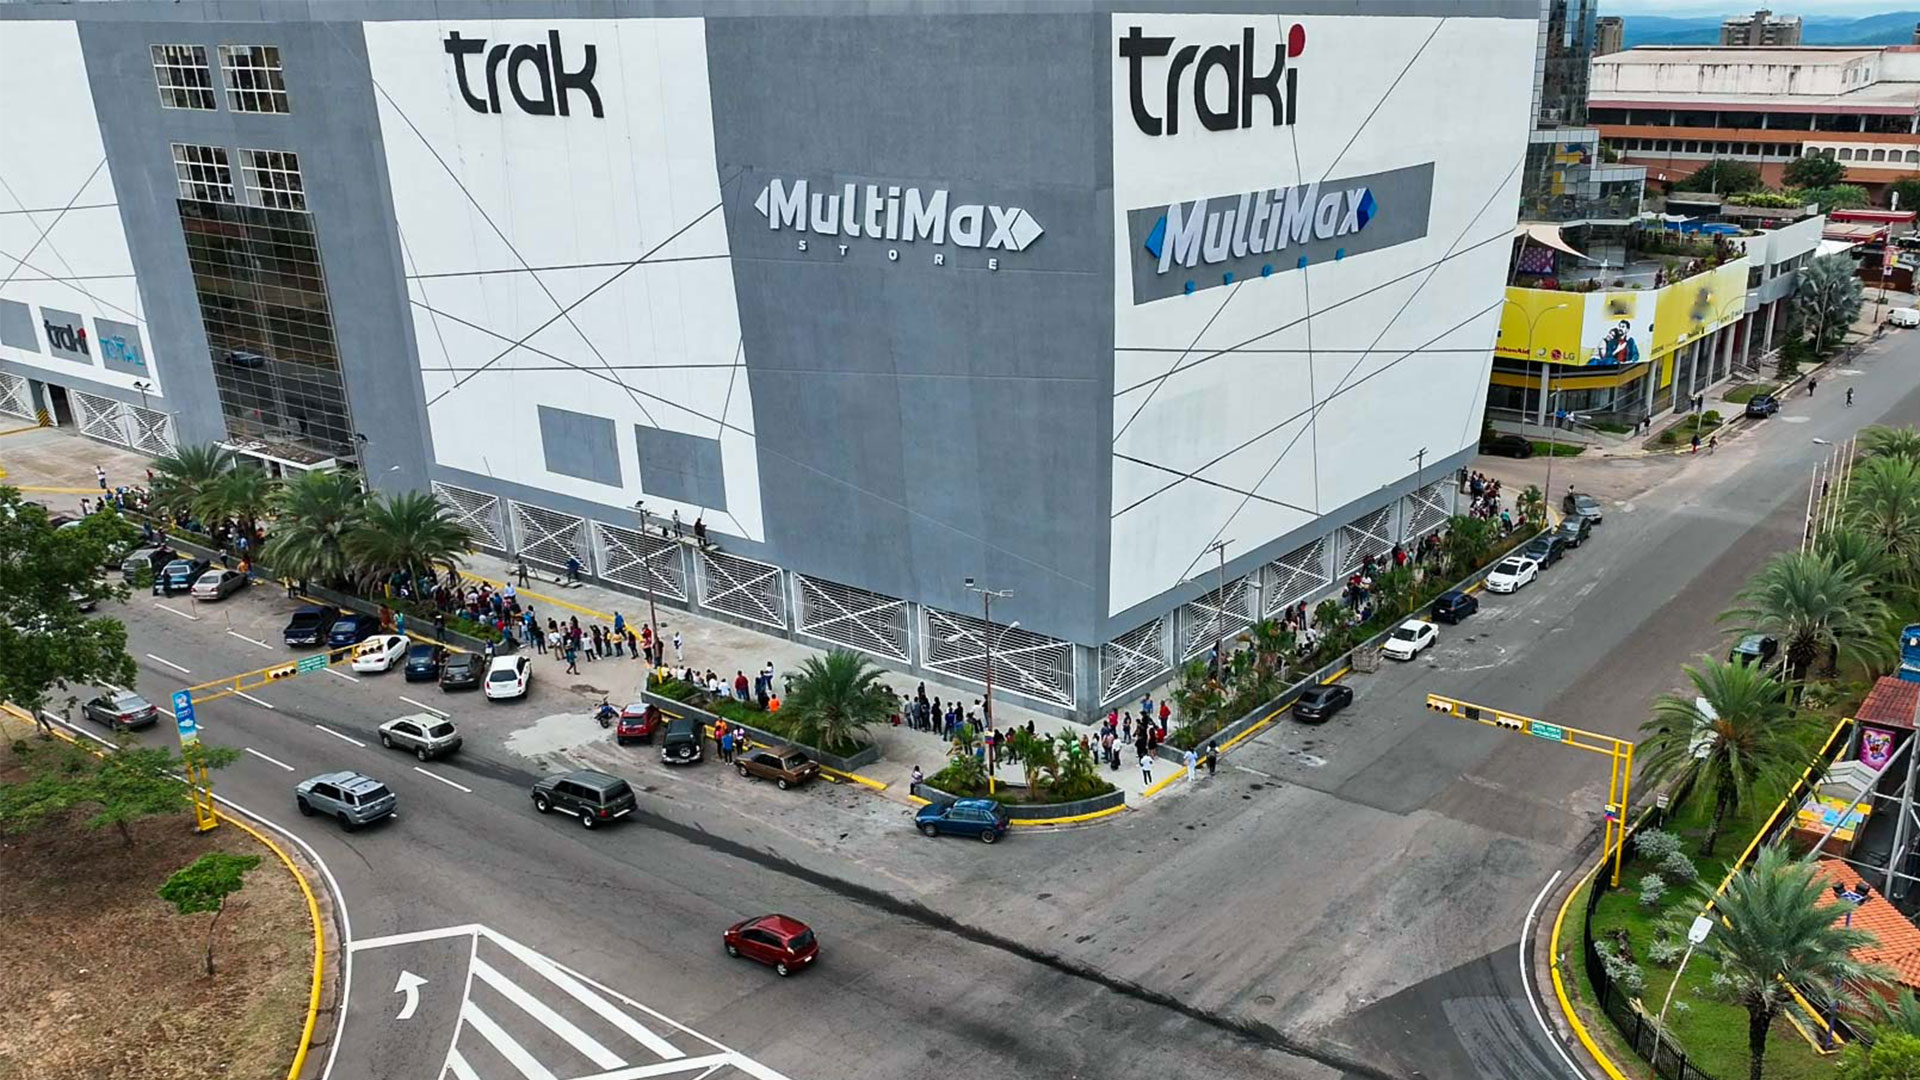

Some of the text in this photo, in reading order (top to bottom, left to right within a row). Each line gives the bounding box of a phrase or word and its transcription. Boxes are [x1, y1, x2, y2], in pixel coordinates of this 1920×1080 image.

[444, 29, 604, 118] trak
[1119, 24, 1306, 137] traki
[769, 178, 1022, 251] MultiMax
[1157, 181, 1369, 274] MultiMax
[798, 239, 998, 270] STORE
[44, 319, 89, 356] traki
[1563, 352, 1575, 361] LG
